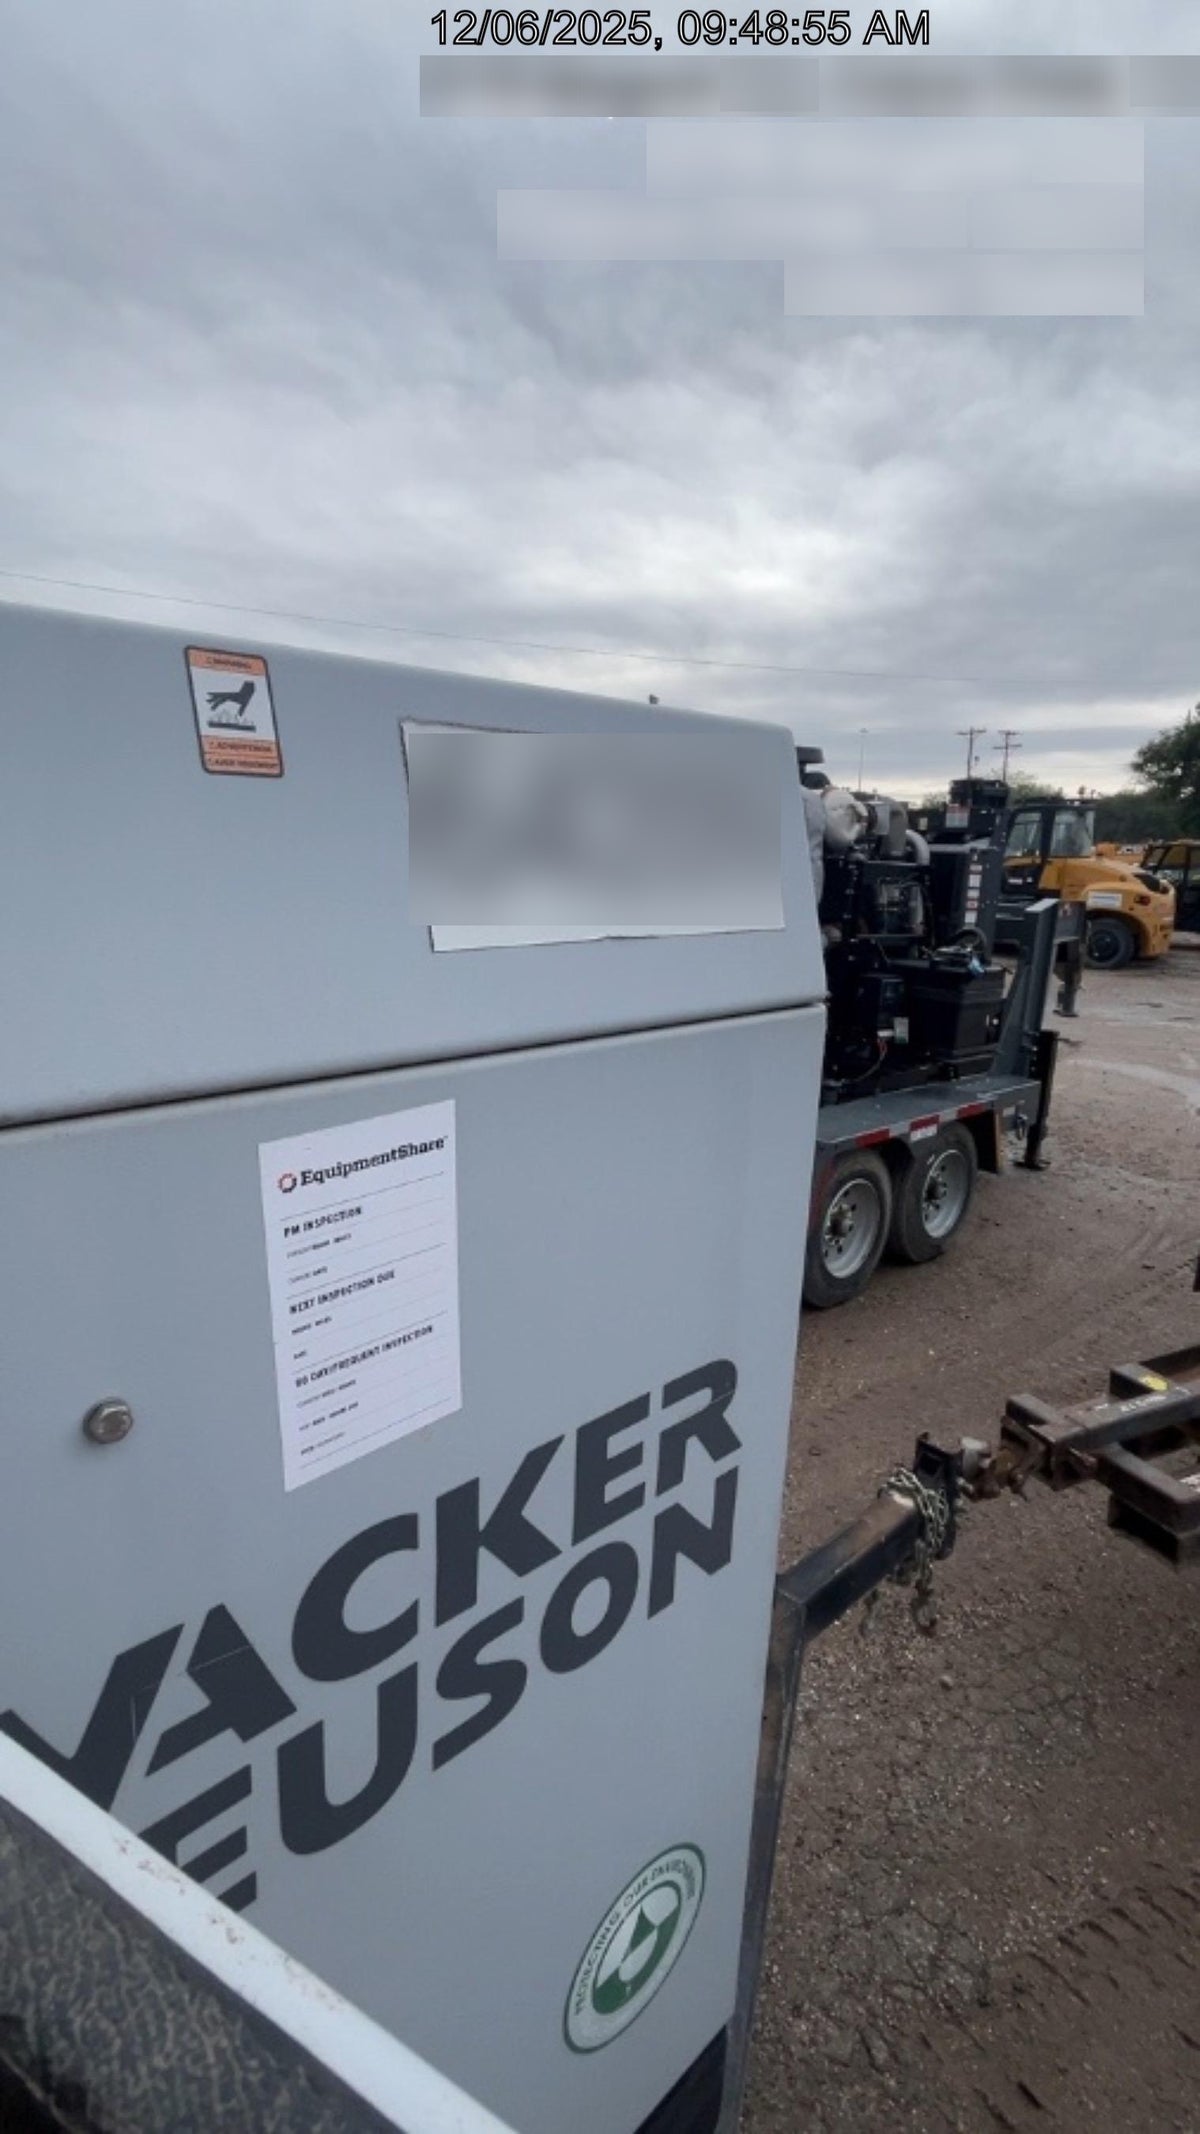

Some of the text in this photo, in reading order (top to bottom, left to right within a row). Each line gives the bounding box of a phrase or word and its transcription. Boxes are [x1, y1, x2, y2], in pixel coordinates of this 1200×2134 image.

[301, 1138, 445, 1186] EquipmentShare
[284, 1206, 362, 1238] PM INSPECTION
[317, 1277, 375, 1305] INSPECTION
[382, 1325, 433, 1352] INSPECTION
